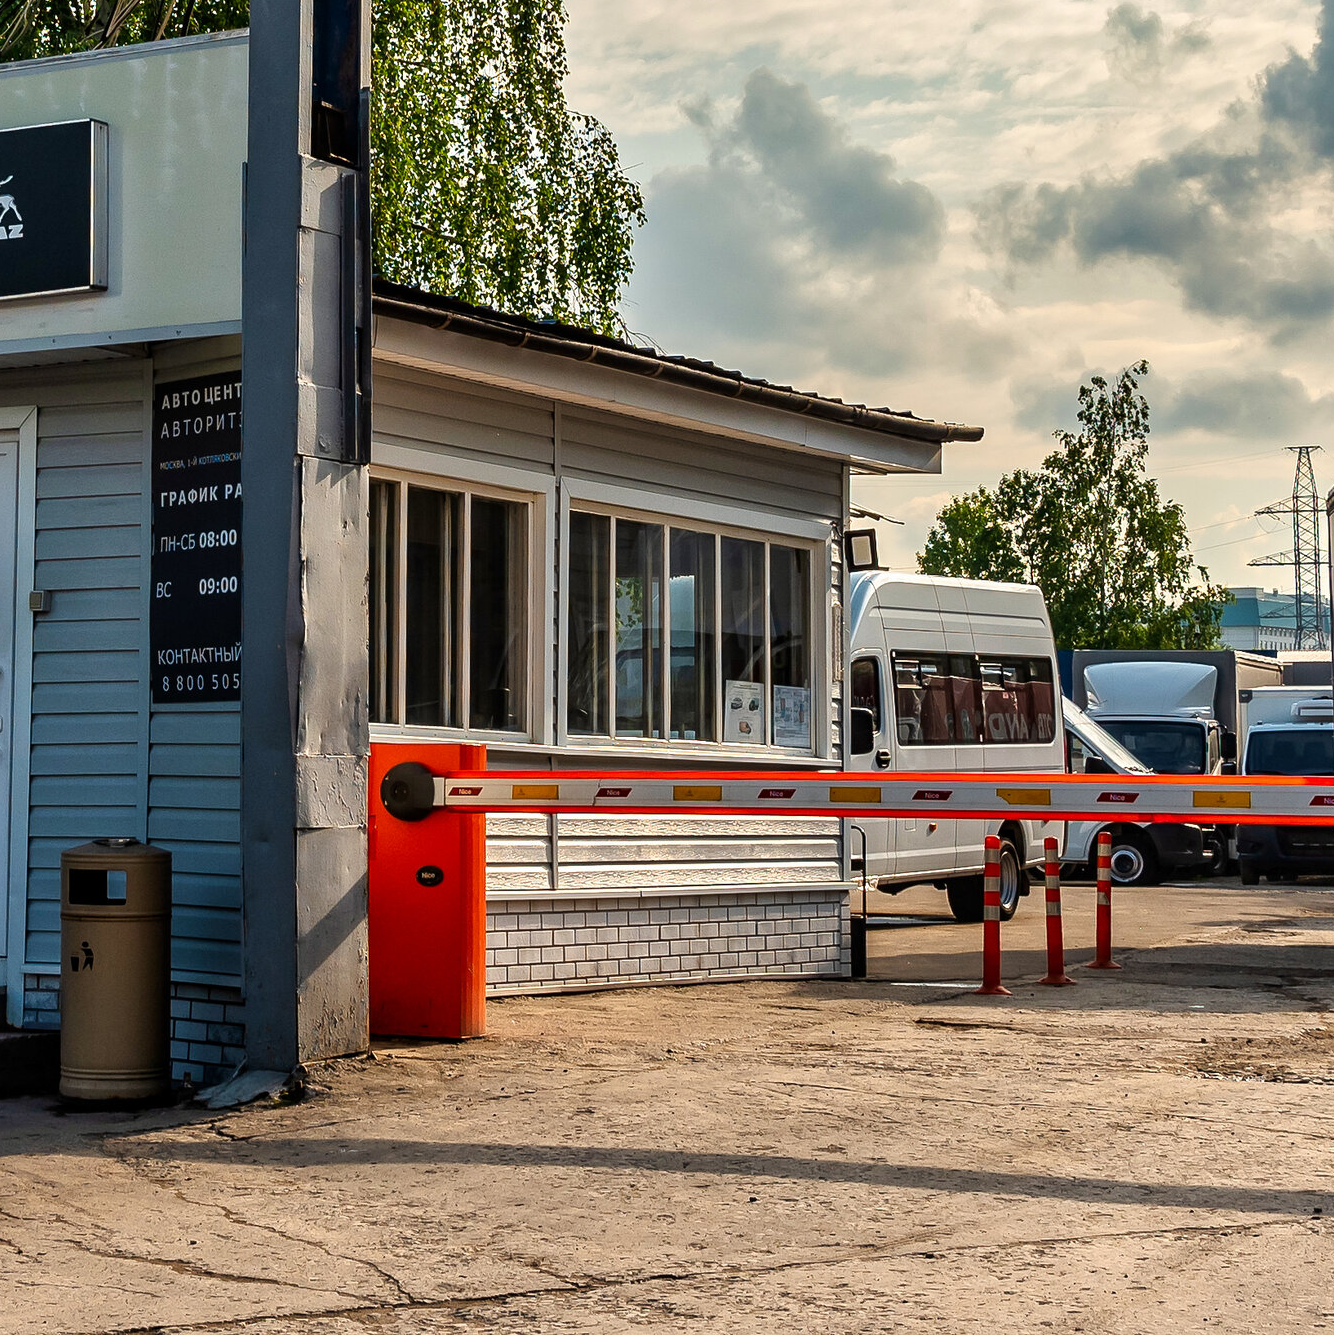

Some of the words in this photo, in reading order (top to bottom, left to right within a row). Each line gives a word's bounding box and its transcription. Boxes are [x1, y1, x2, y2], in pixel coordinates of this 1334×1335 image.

[160, 485, 218, 508] ГРАФИК
[224, 483, 243, 500] РА
[160, 533, 196, 553] ПН-СБ
[199, 528, 237, 549] 08:00
[156, 581, 172, 598] ВС
[199, 576, 238, 595] 09:00
[157, 641, 243, 666] КОНТАКТНЫЙ
[162, 675, 170, 692] 8
[176, 674, 205, 691] 800
[211, 672, 241, 690] 505
[1109, 794, 1125, 802] Nice
